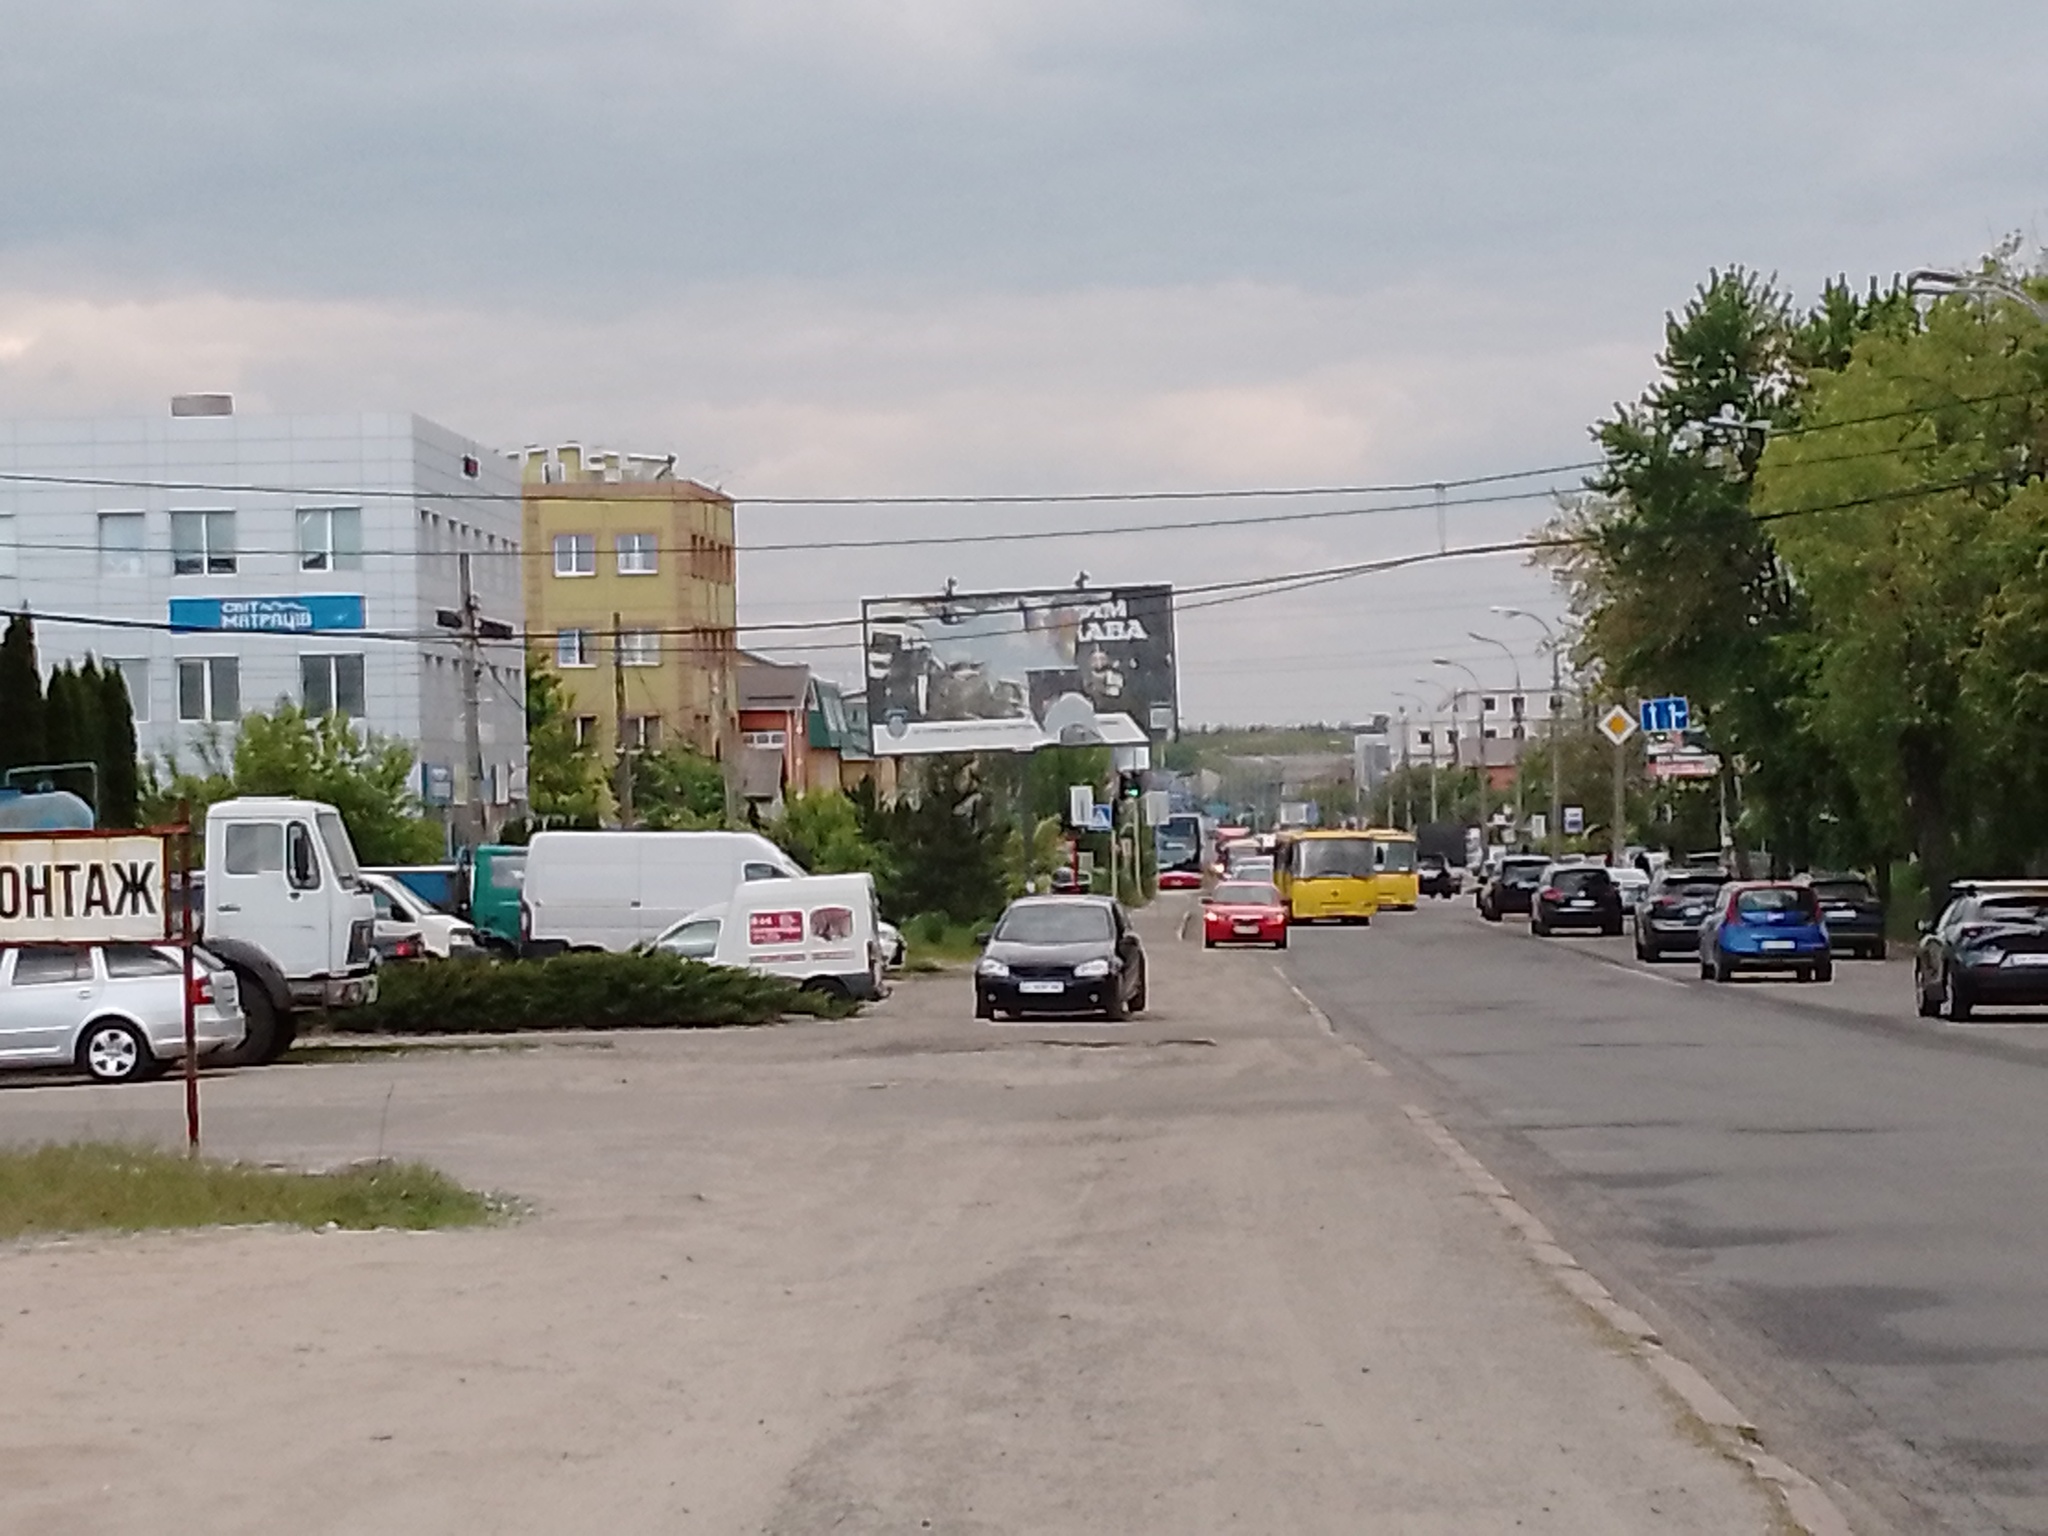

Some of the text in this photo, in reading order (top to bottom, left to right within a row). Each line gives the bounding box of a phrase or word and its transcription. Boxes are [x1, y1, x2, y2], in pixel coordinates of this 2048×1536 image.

[221, 601, 258, 613] СВІТ
[221, 611, 313, 630] МАТРАЦІВ
[0, 862, 157, 918] ОНТАЖ
